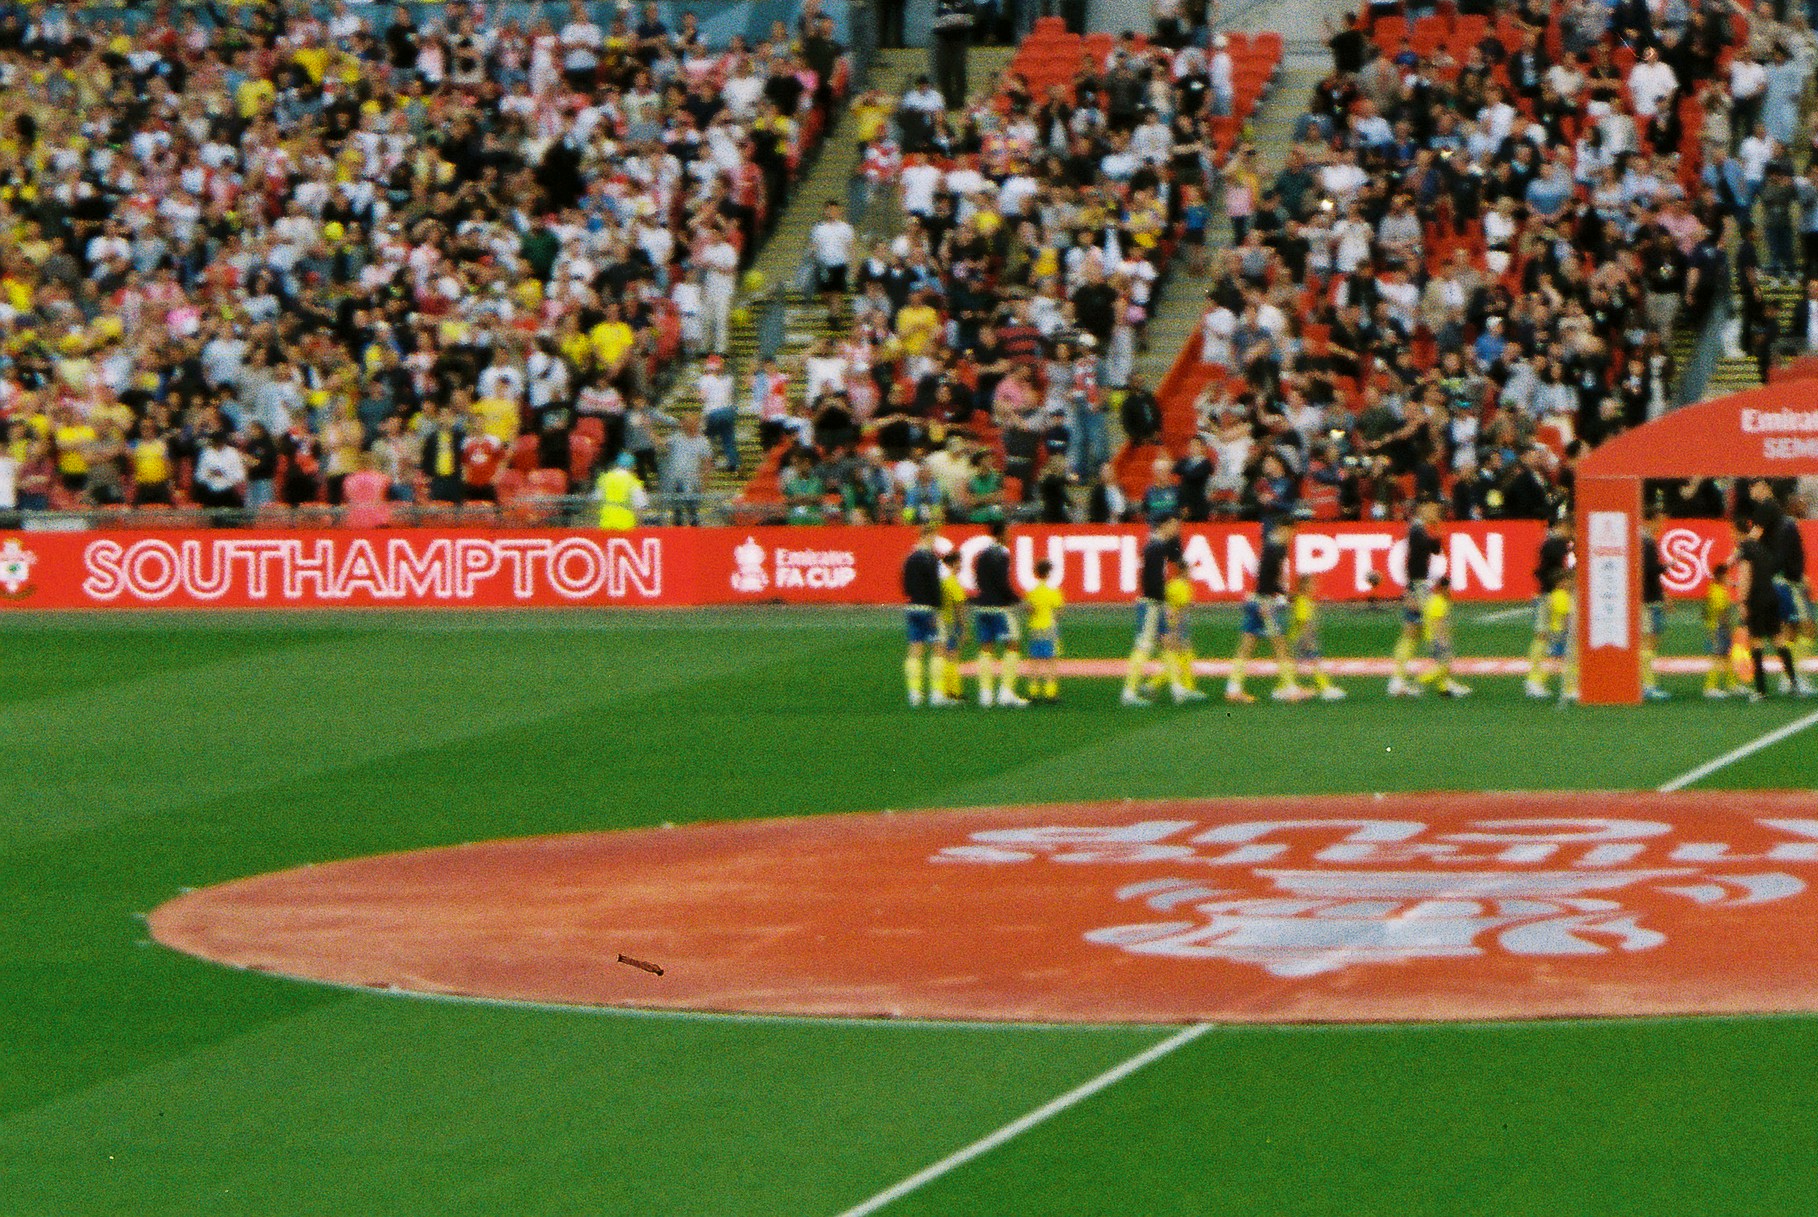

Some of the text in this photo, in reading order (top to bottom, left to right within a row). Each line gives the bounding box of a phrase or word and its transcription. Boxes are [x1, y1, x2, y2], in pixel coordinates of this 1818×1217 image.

[83, 538, 663, 600] SOUTHAMPTON
[775, 566, 857, 590] FA CUP
